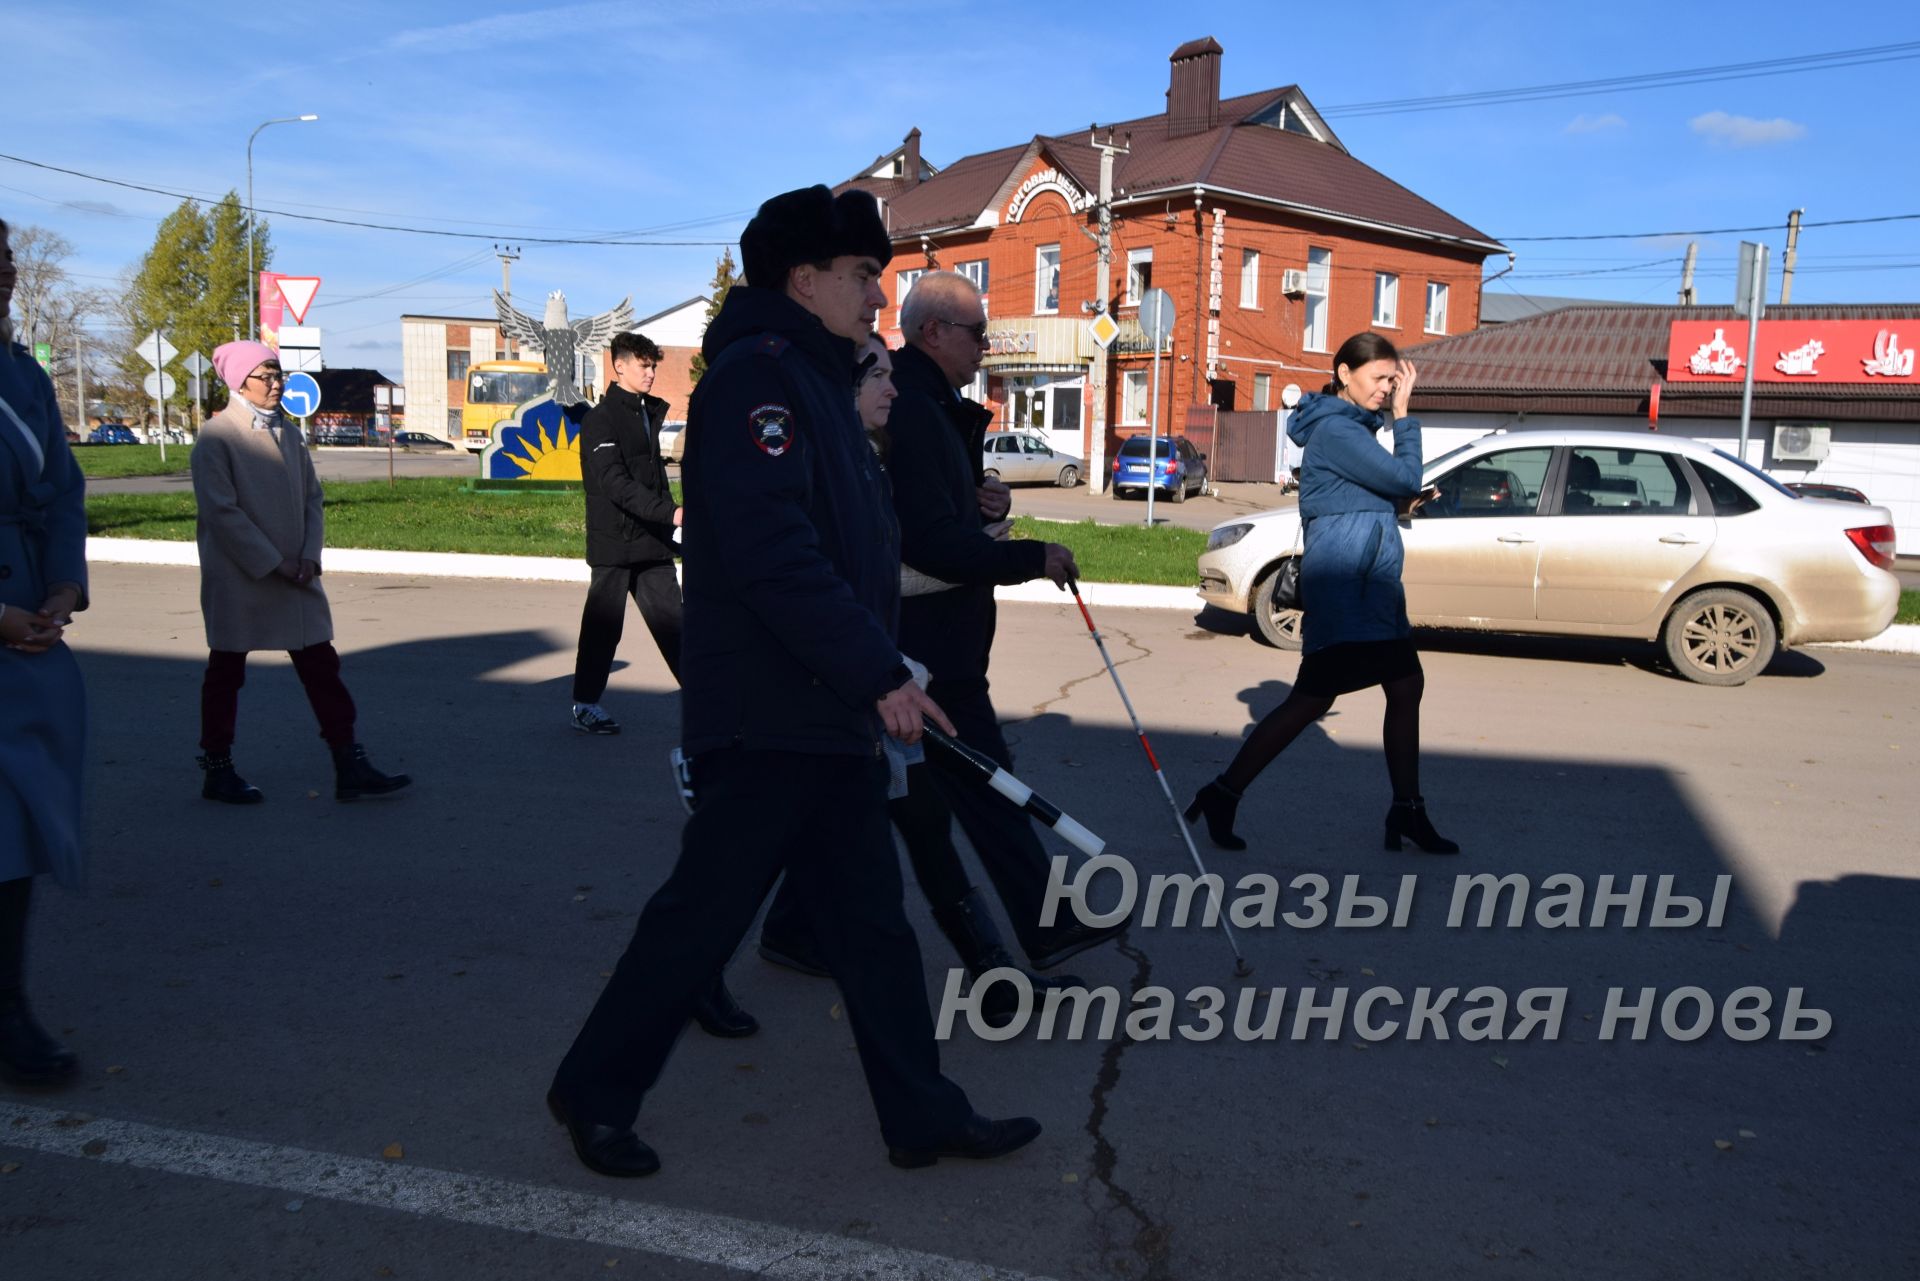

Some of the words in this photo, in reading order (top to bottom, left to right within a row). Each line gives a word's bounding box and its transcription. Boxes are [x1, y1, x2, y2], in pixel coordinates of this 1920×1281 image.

[1005, 167, 1057, 223] ТОРГОВЫЙ
[1056, 173, 1085, 211] ЦЕНТР
[1209, 208, 1226, 310] ТОРГОВЫЙ
[1206, 319, 1220, 381] ЦЕНТР
